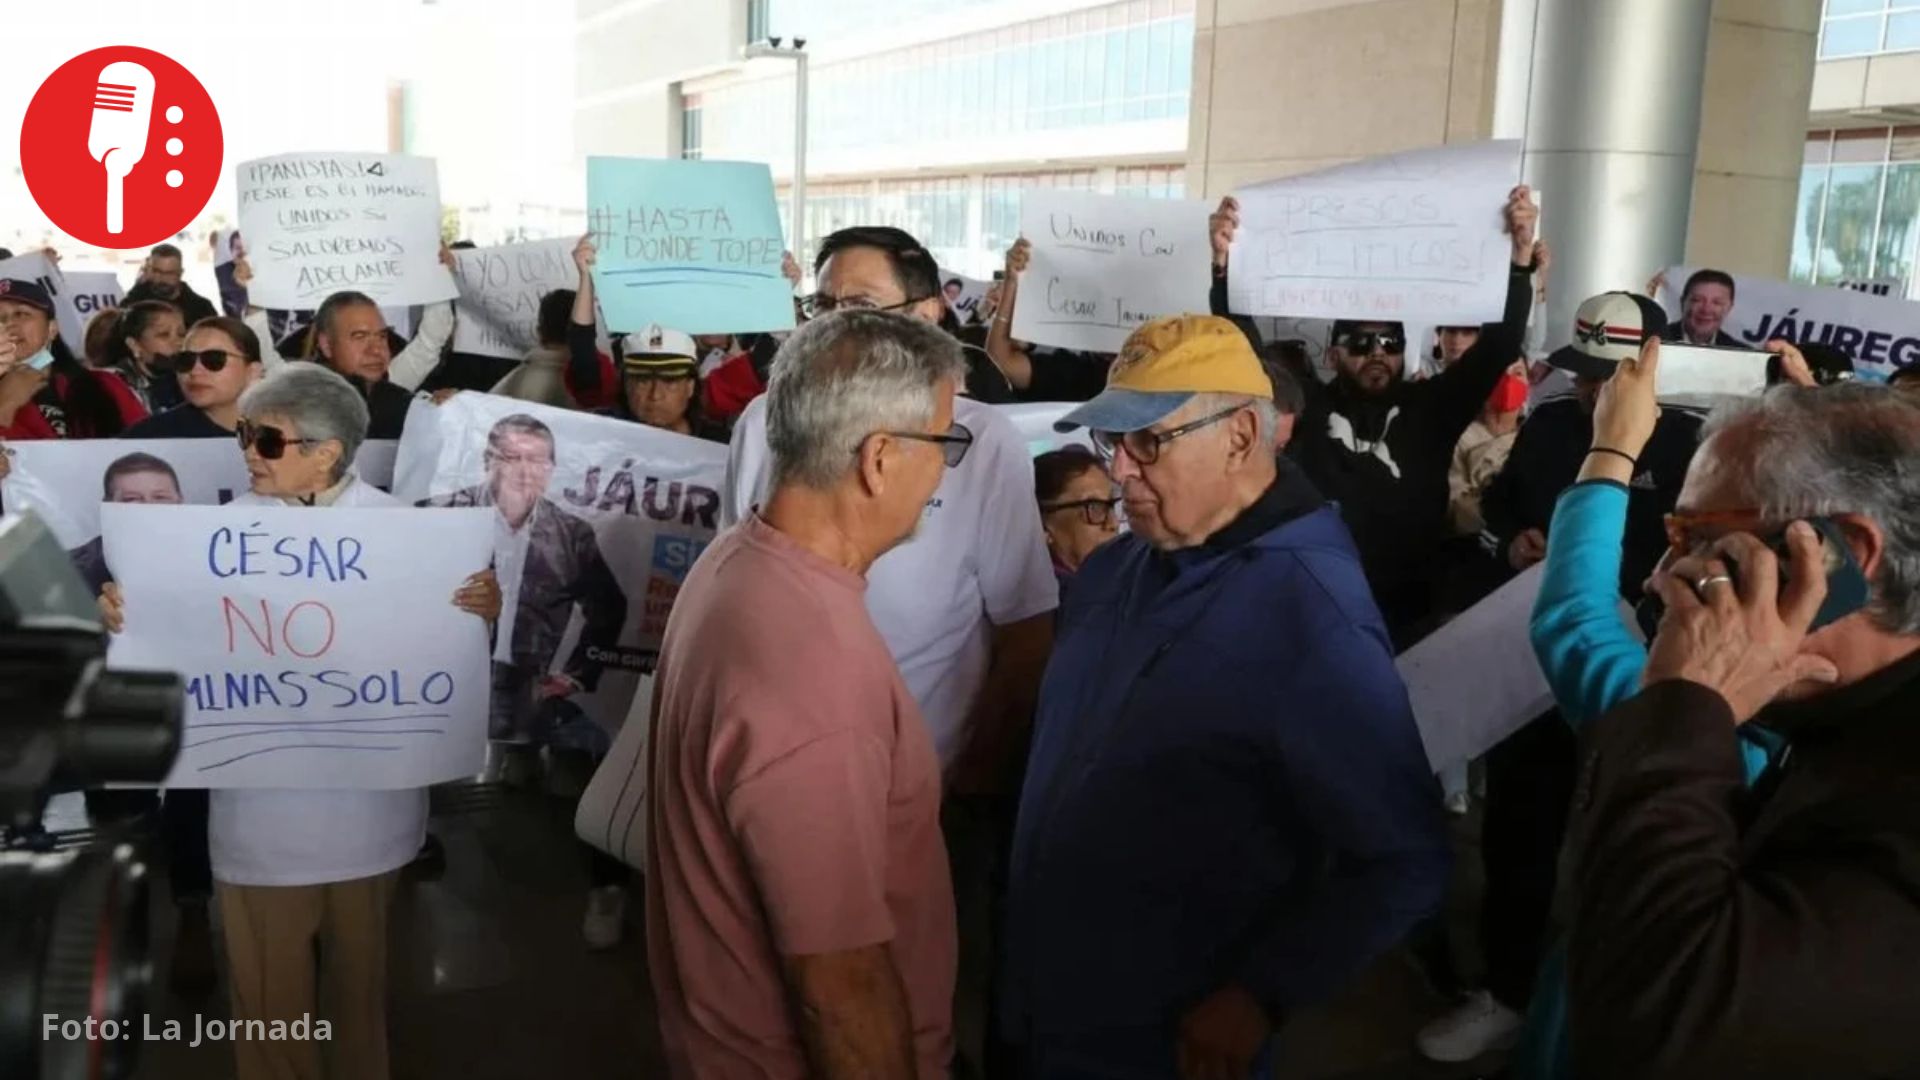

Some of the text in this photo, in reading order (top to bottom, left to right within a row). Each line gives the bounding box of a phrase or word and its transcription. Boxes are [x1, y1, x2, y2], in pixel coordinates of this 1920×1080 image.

[624, 234, 781, 266] DONDE TOPE
[207, 521, 368, 582] CÉSAR
[223, 596, 335, 659] NO
[310, 669, 454, 709] SOLO
